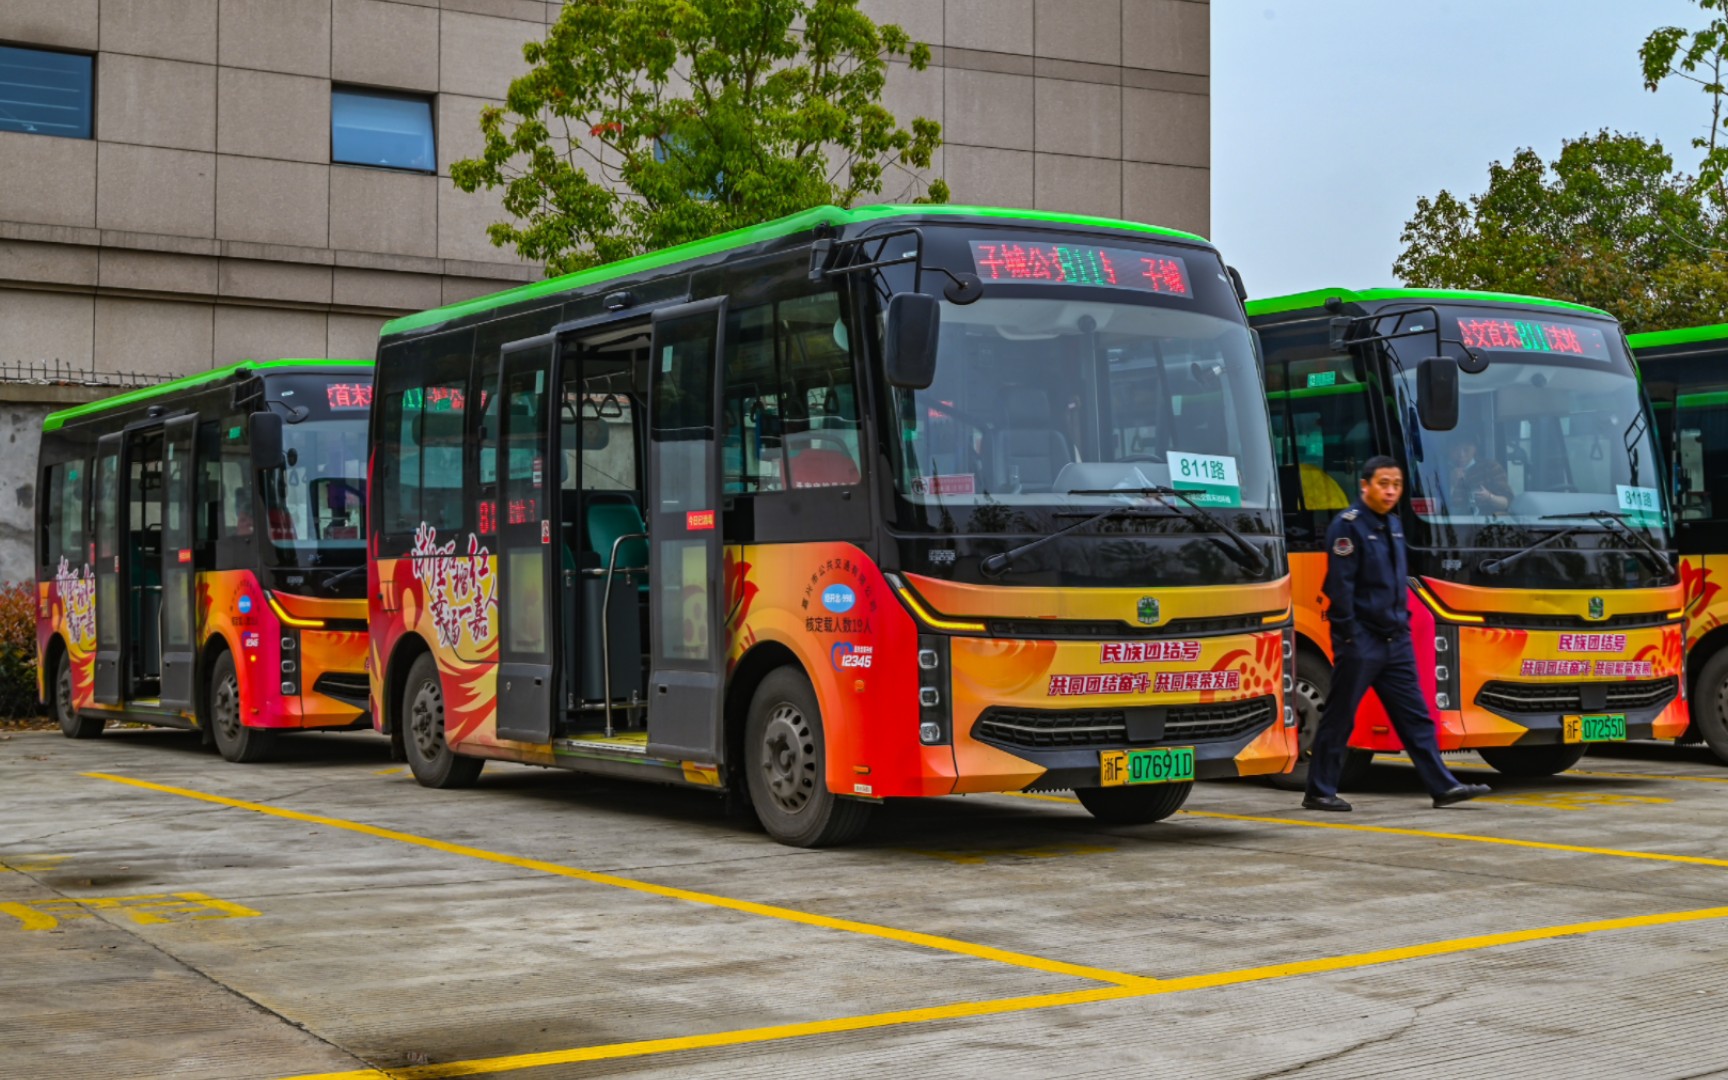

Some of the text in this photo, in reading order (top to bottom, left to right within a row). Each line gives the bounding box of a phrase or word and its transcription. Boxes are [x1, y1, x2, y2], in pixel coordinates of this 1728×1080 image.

[1057, 247, 1103, 285] 811
[1515, 321, 1549, 350] 811
[1180, 458, 1225, 480] 811路
[1625, 490, 1652, 507] 811路
[805, 616, 872, 634] 核定载人数19人
[1101, 641, 1200, 663] 民族团结号
[1558, 634, 1627, 652] 民族团结号
[841, 655, 872, 668] 12345
[1049, 671, 1240, 696] 共同团结奋斗 共同繁荣发展
